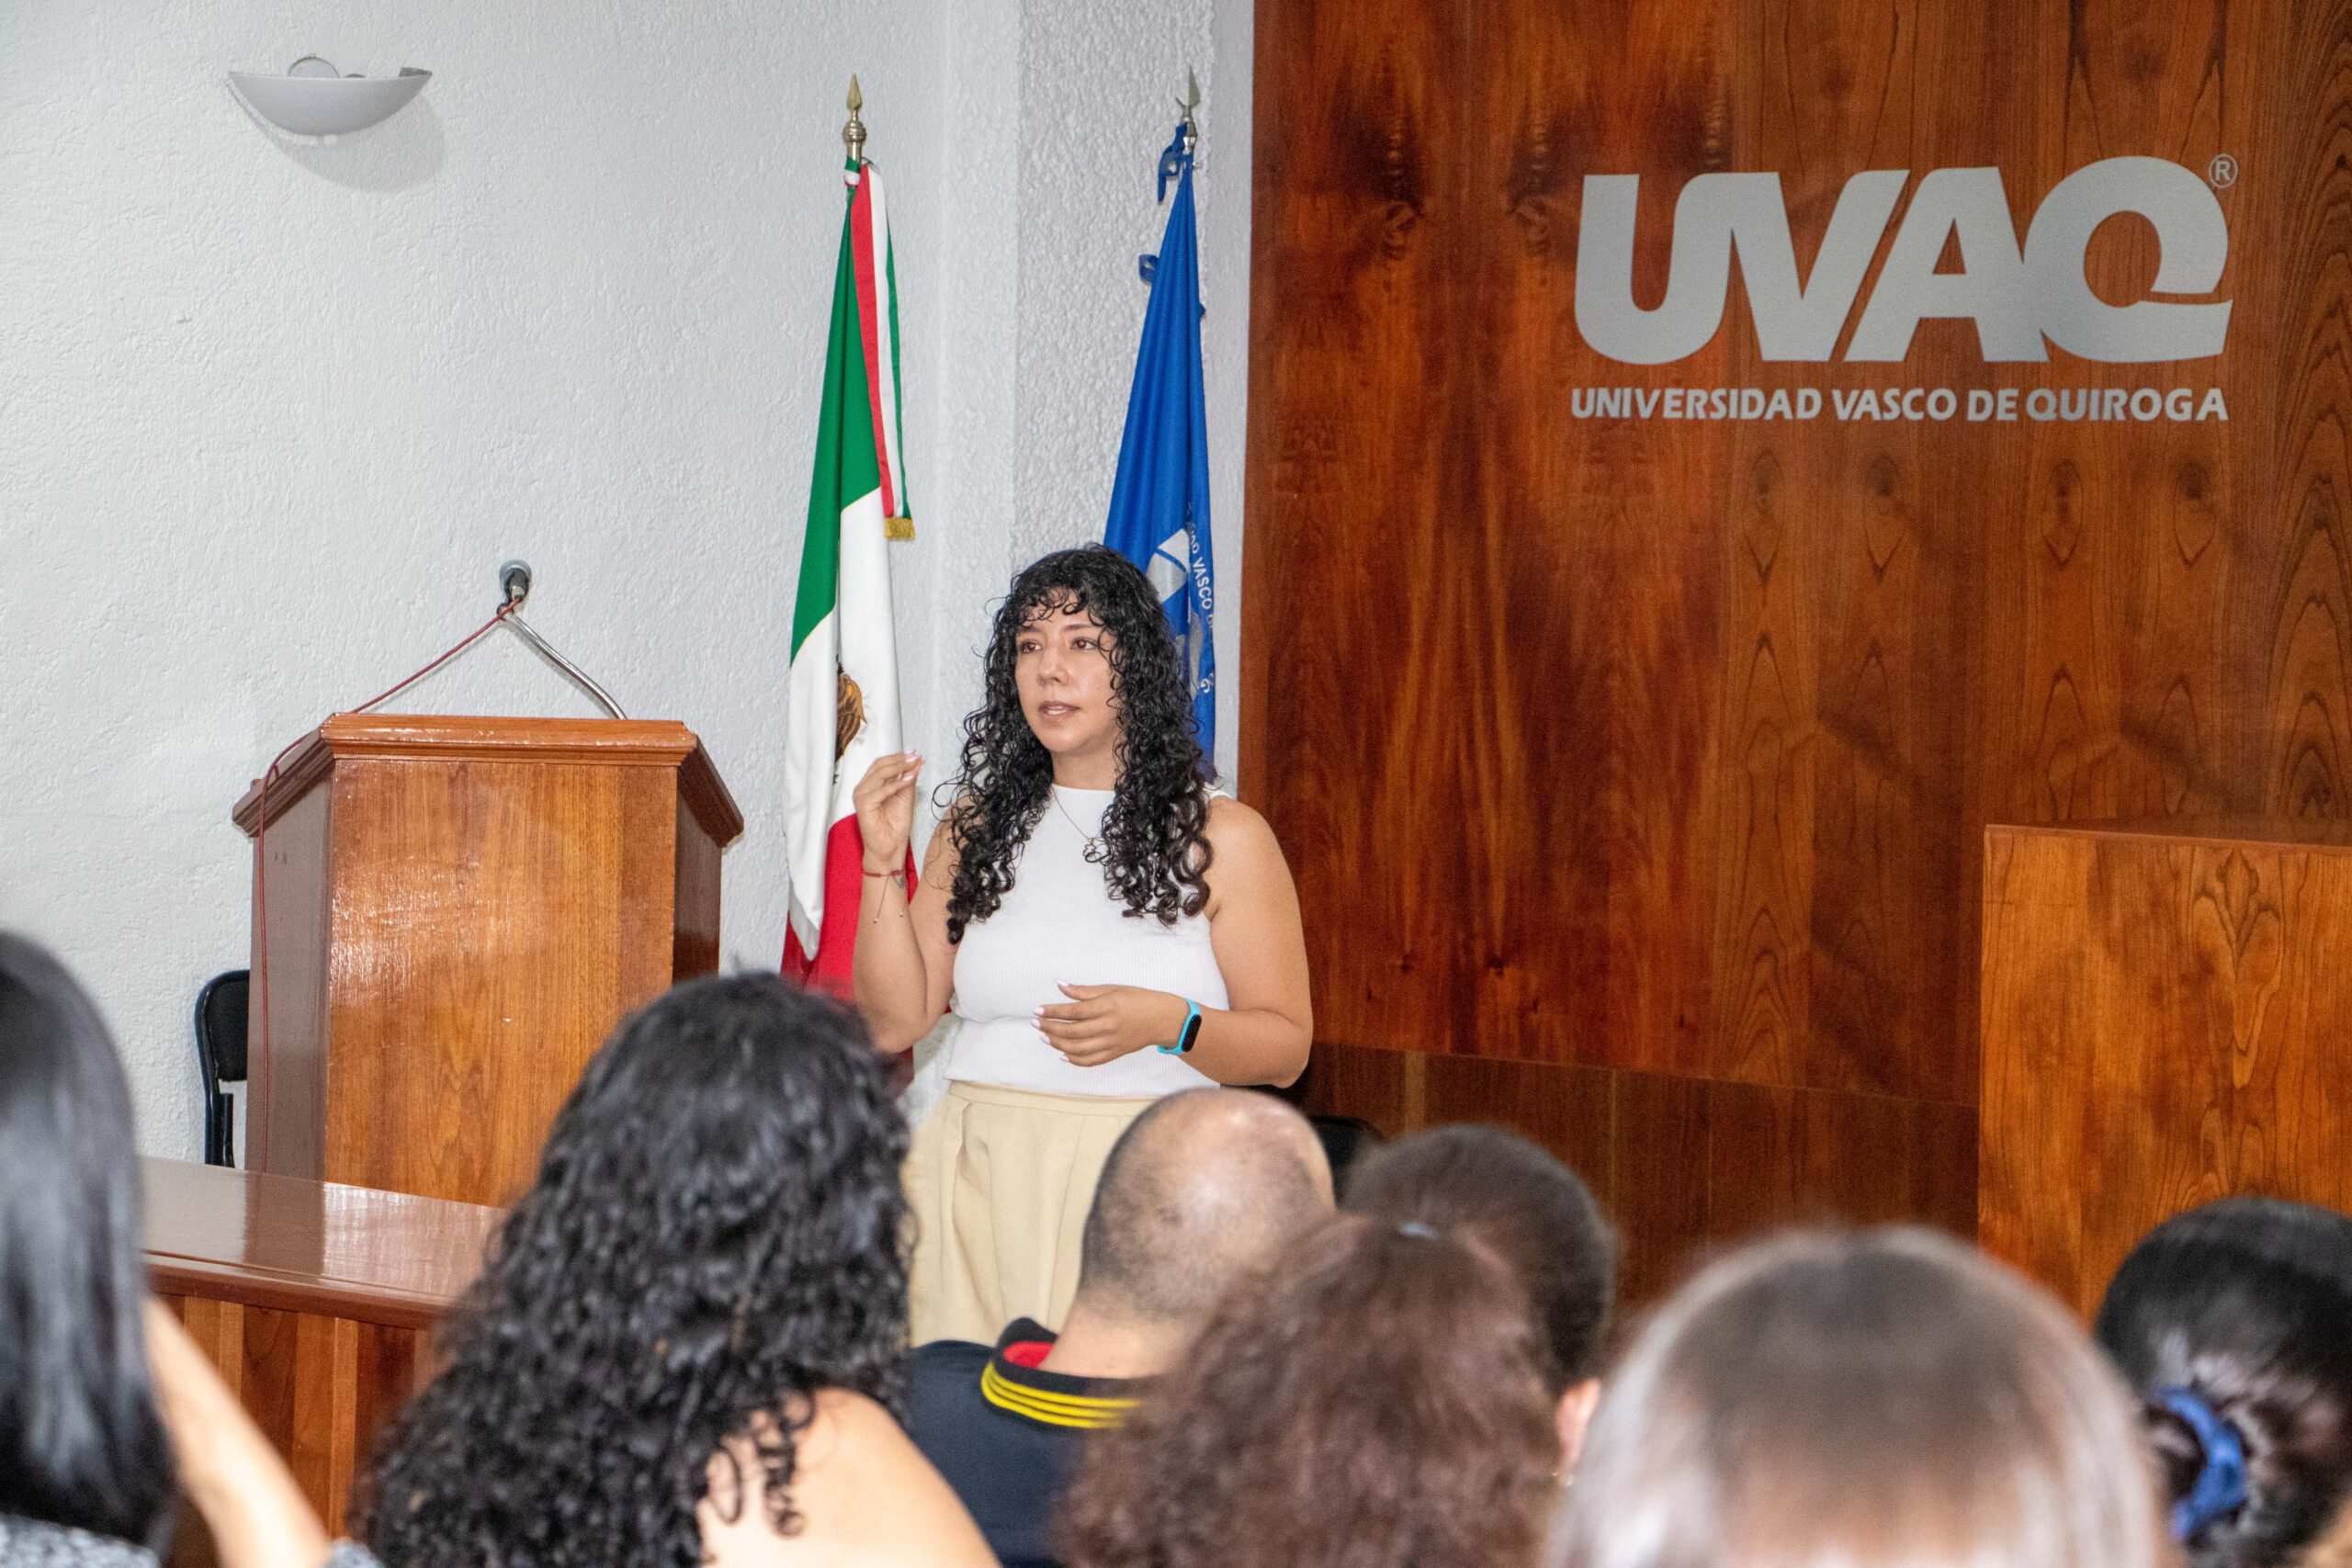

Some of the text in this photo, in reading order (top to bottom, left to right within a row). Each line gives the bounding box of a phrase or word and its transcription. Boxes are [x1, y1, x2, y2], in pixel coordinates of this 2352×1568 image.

[1574, 155, 2233, 366] UVAQ
[1570, 386, 2230, 423] UNIVERSIDAD VASCO DE QUIROGA
[1193, 556, 1213, 610] VASCO
